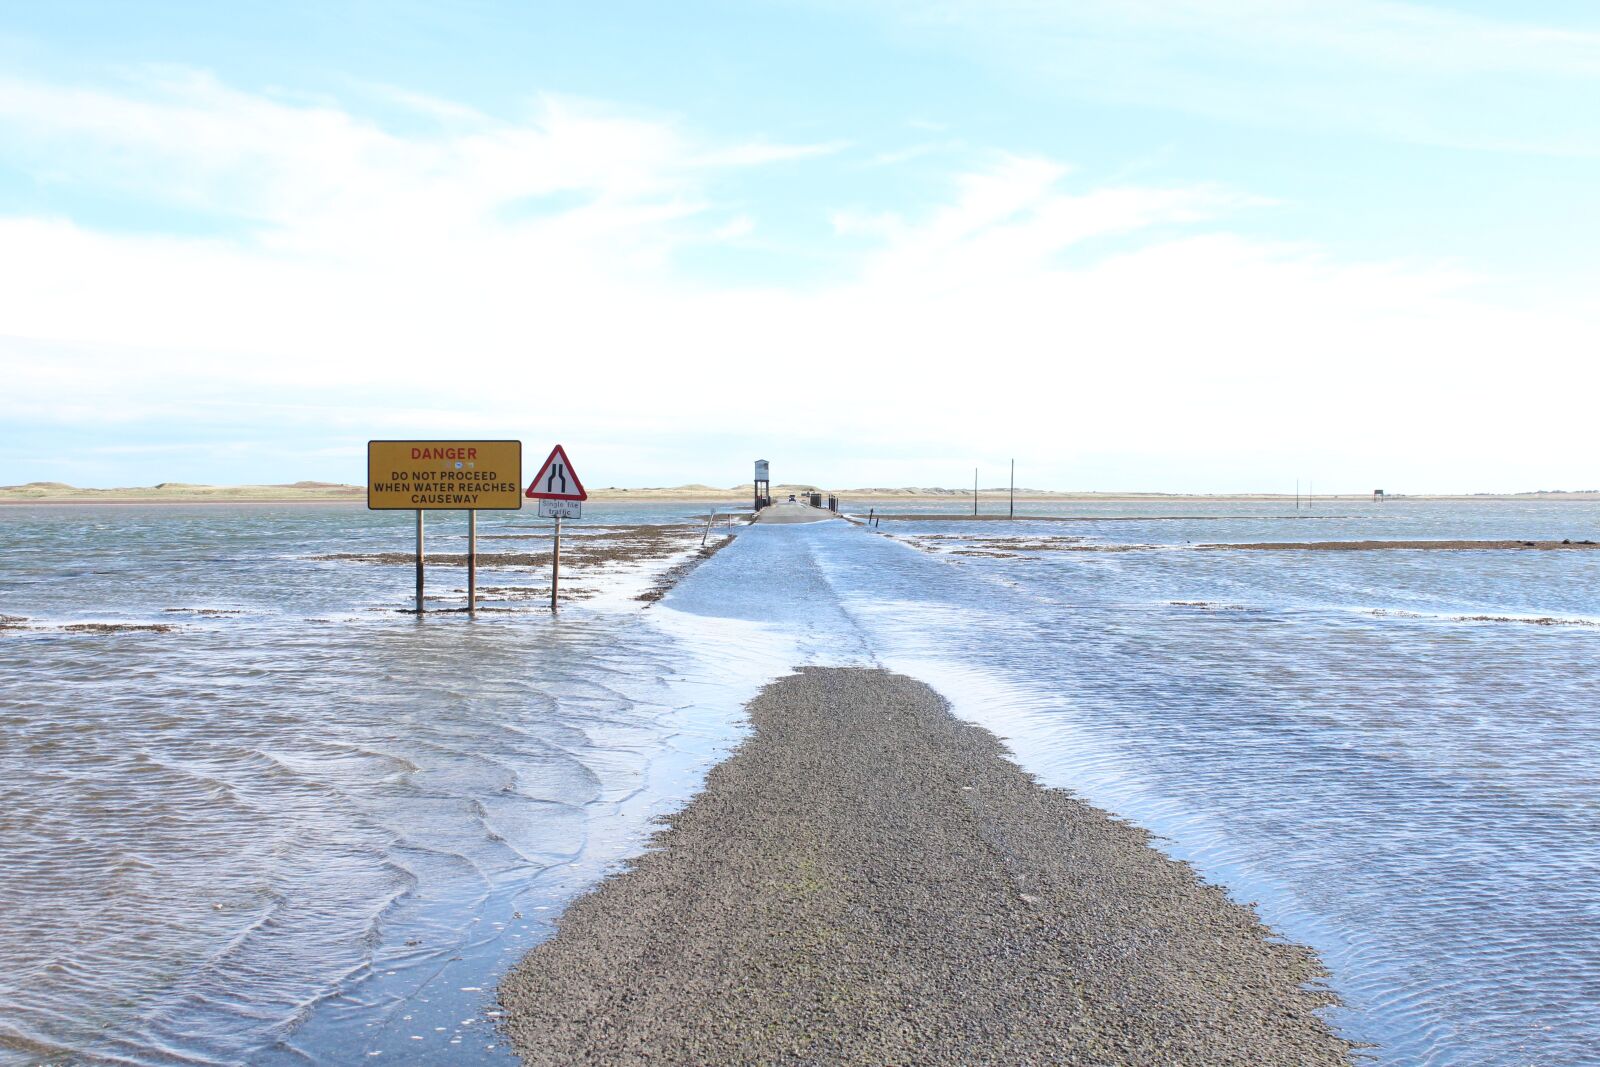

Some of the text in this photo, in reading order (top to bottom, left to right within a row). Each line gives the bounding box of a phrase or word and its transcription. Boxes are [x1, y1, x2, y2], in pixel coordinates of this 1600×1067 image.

[411, 448, 477, 459] DANGER
[391, 471, 497, 481] DO NOT PROCEED
[374, 483, 515, 492] WHEN WATER REACHES
[411, 494, 479, 503] CAUSEWAY
[542, 500, 564, 508] Single
[548, 508, 571, 516] traffic
